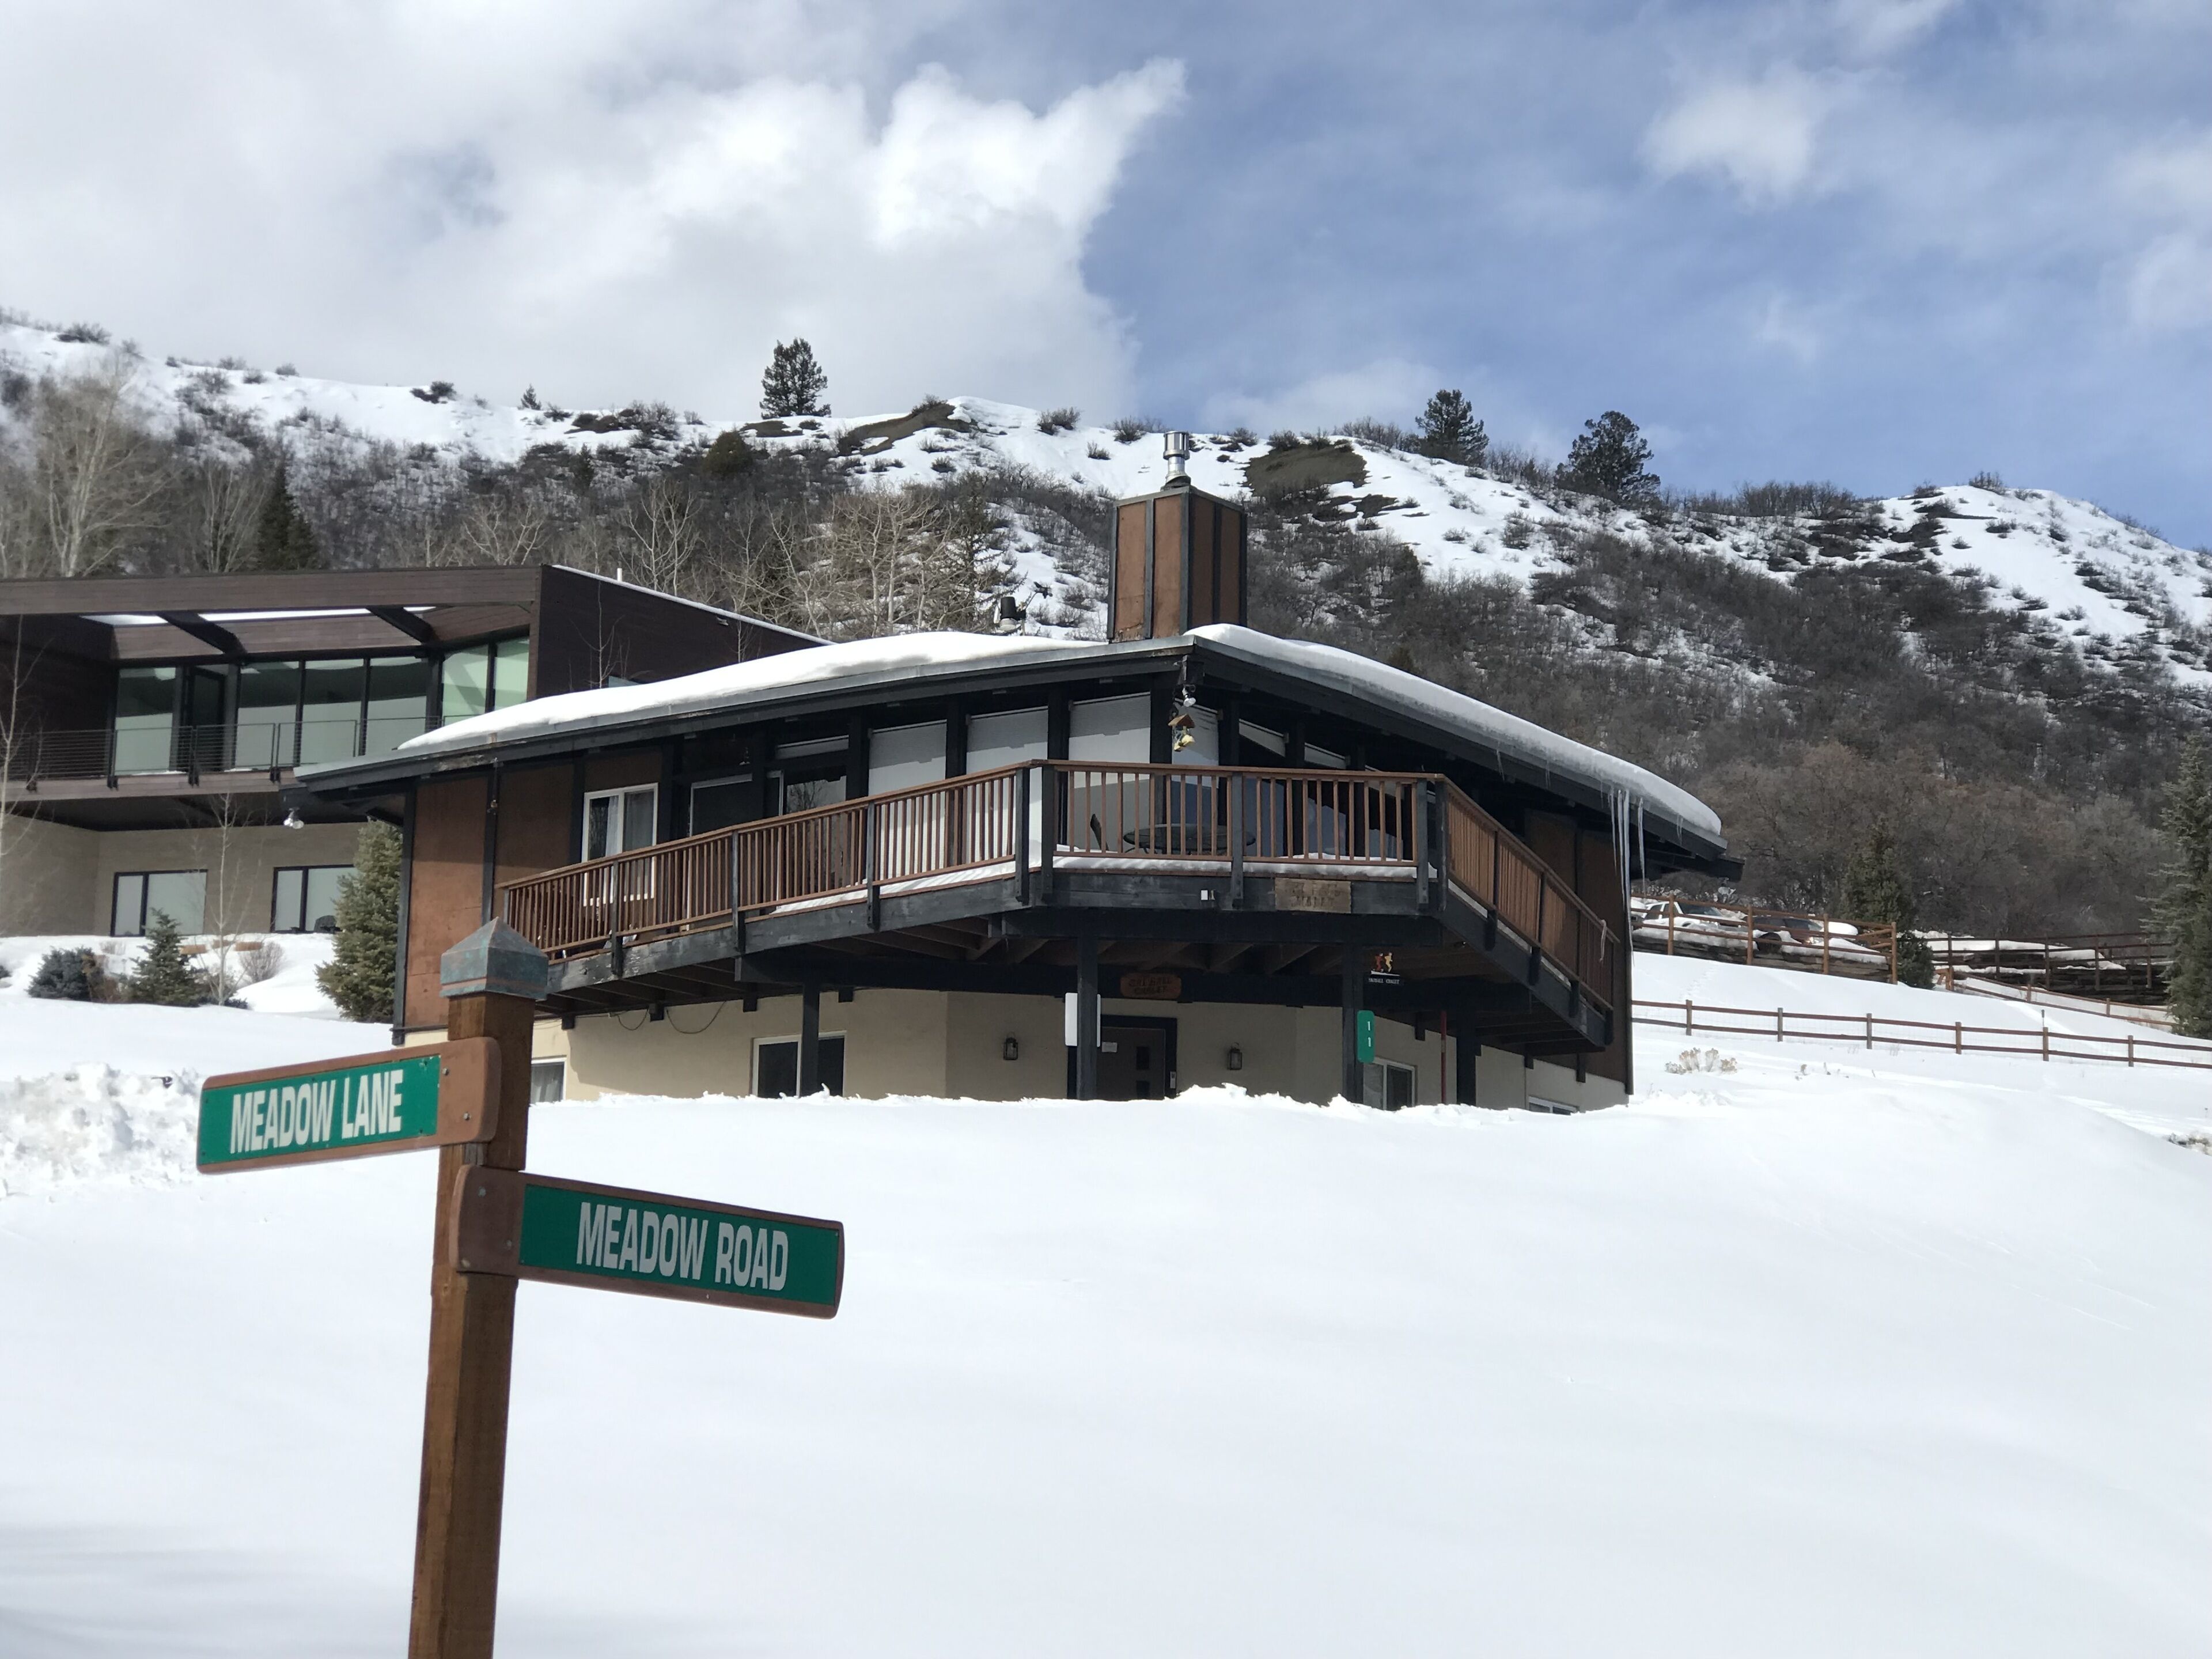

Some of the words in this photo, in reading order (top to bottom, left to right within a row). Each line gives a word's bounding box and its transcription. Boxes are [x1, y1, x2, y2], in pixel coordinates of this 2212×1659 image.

[230, 1080, 336, 1154] MEADOW
[342, 1069, 403, 1139] LANE
[577, 1202, 709, 1281] MEADOW
[714, 1222, 789, 1291] ROAD
